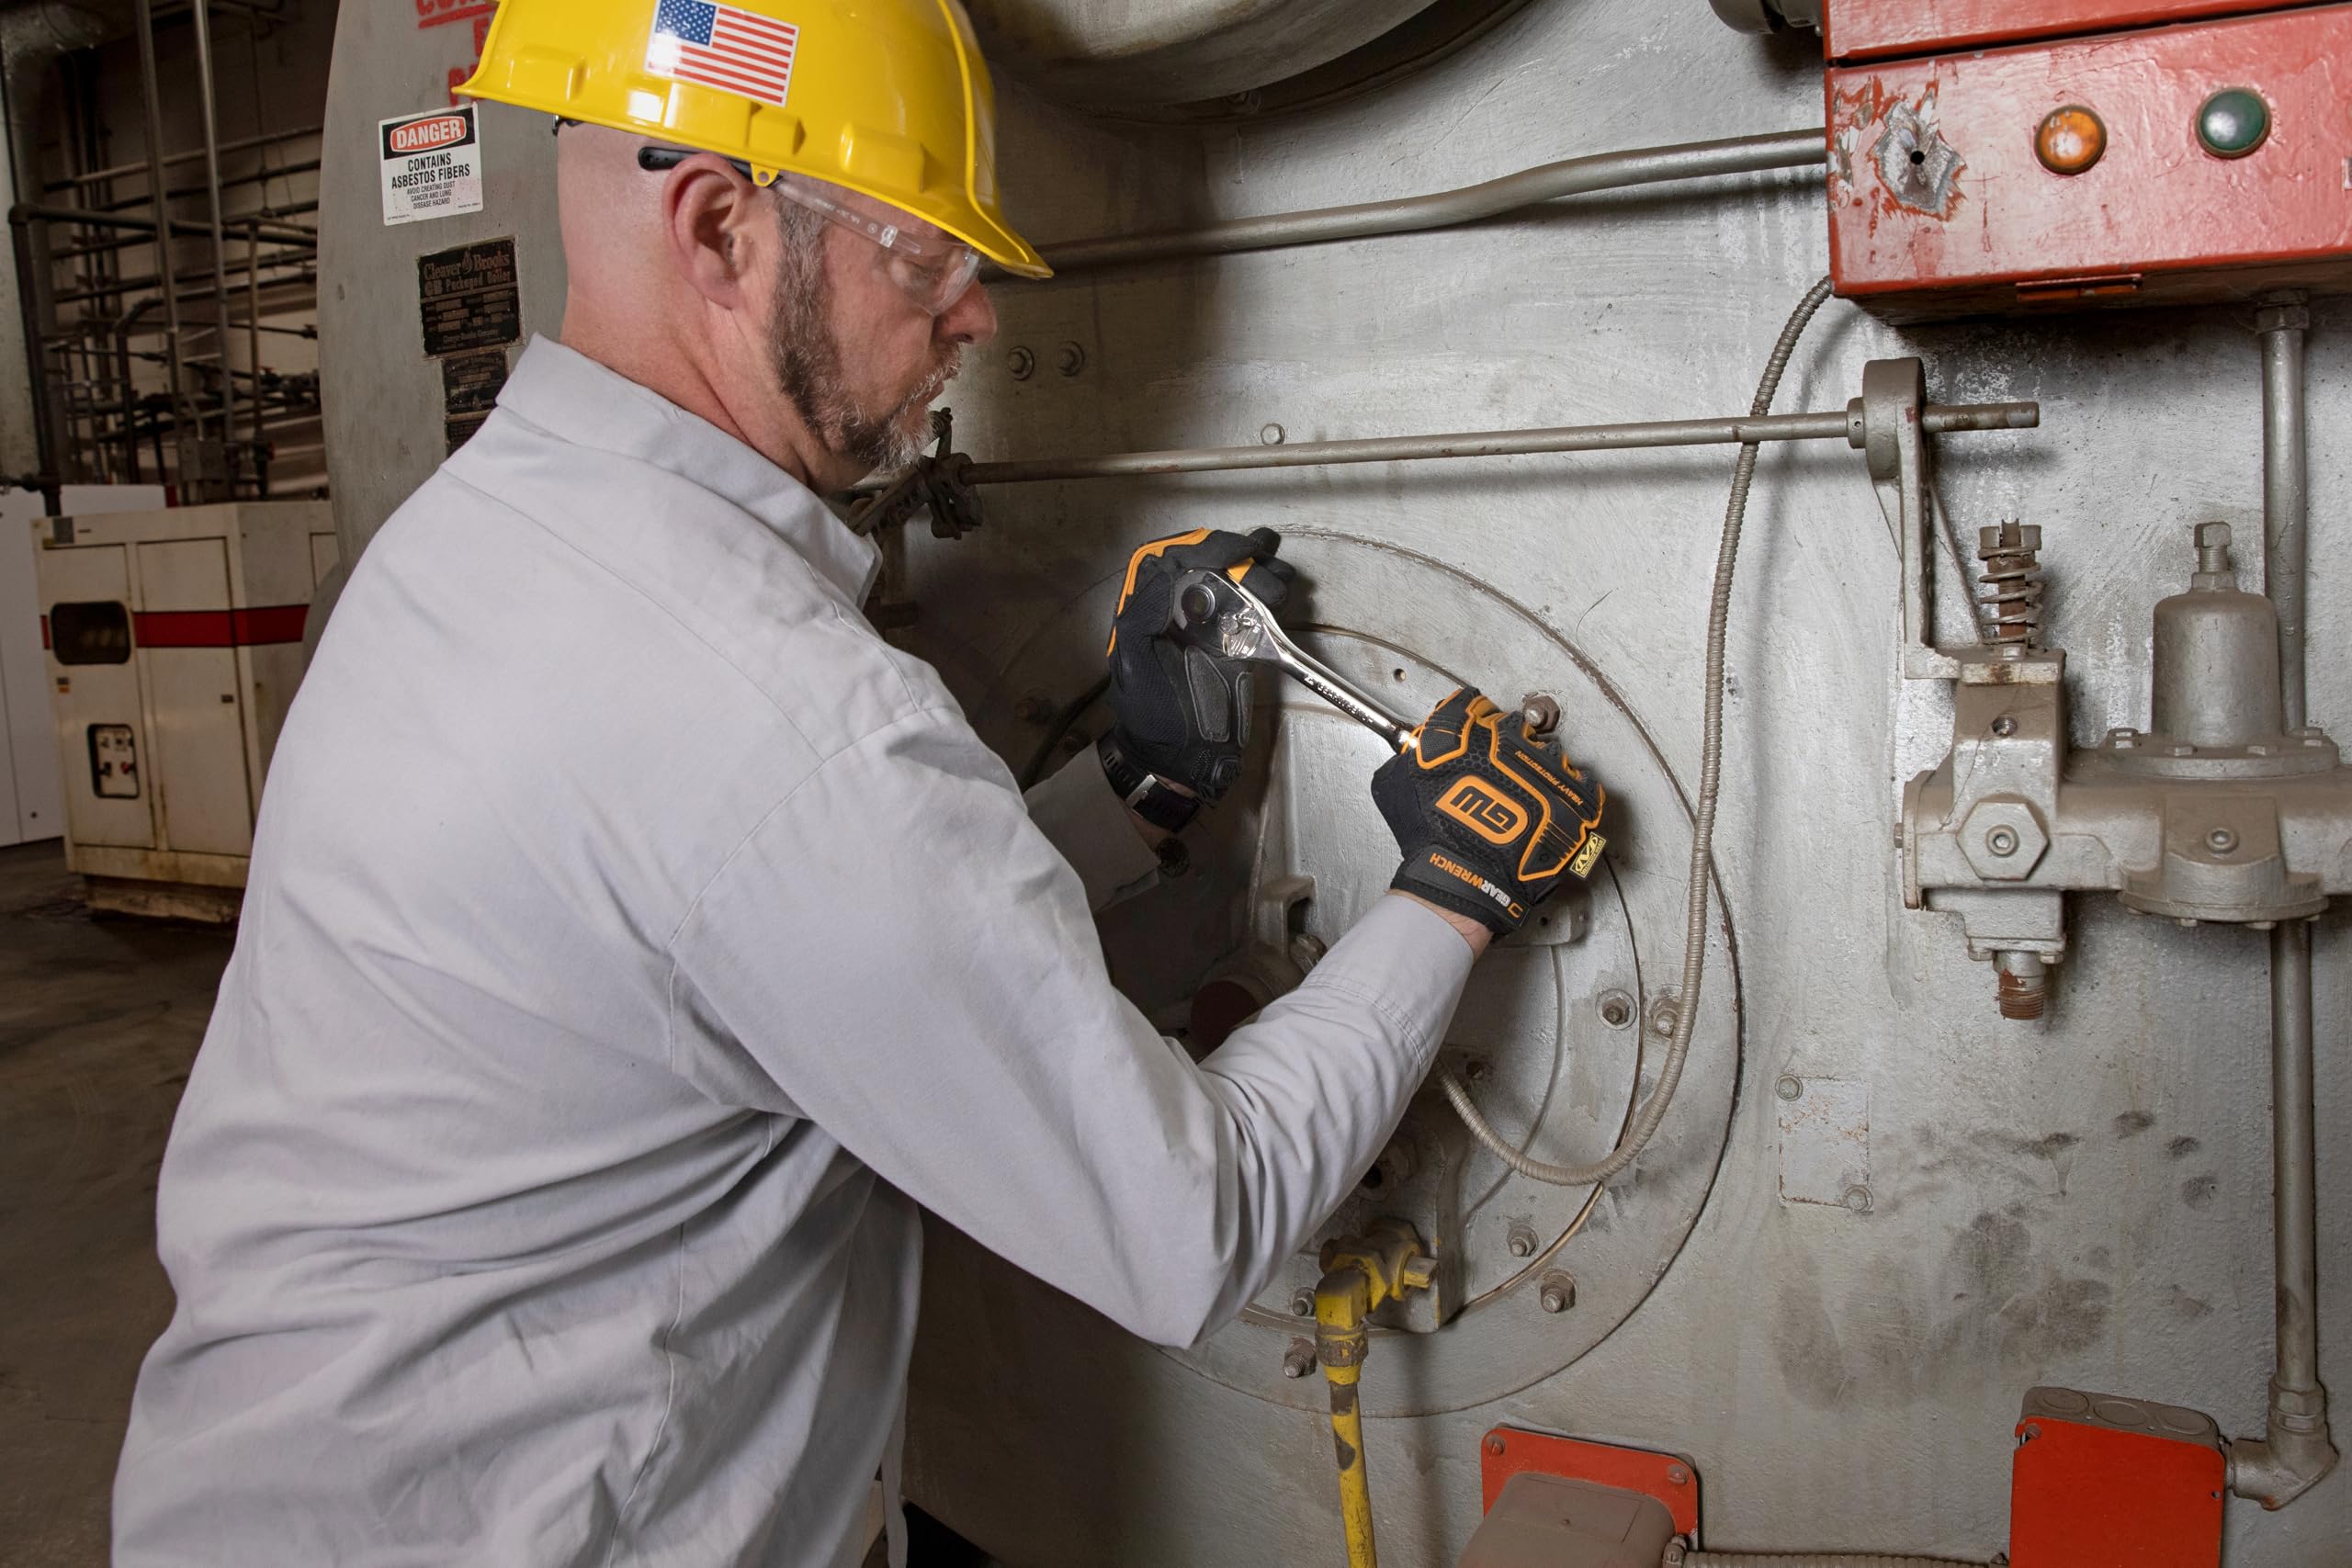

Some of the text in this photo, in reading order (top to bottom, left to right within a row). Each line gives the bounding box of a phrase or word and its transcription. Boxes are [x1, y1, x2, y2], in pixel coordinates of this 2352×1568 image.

[396, 119, 461, 148] DANGER
[408, 152, 451, 172] CONTAINS
[391, 164, 470, 189] ASBESTOS FIBERS
[407, 181, 456, 195] AVOID CREATING DUST
[411, 189, 452, 202] CANCER AND LUNG
[413, 199, 432, 209] DISEASE
[432, 197, 451, 207] HAZARD
[424, 254, 511, 281] Cleaver Brooks
[1514, 750, 1583, 806] HEAVY PROTECTION
[1430, 852, 1511, 908] GEARWRENCH
